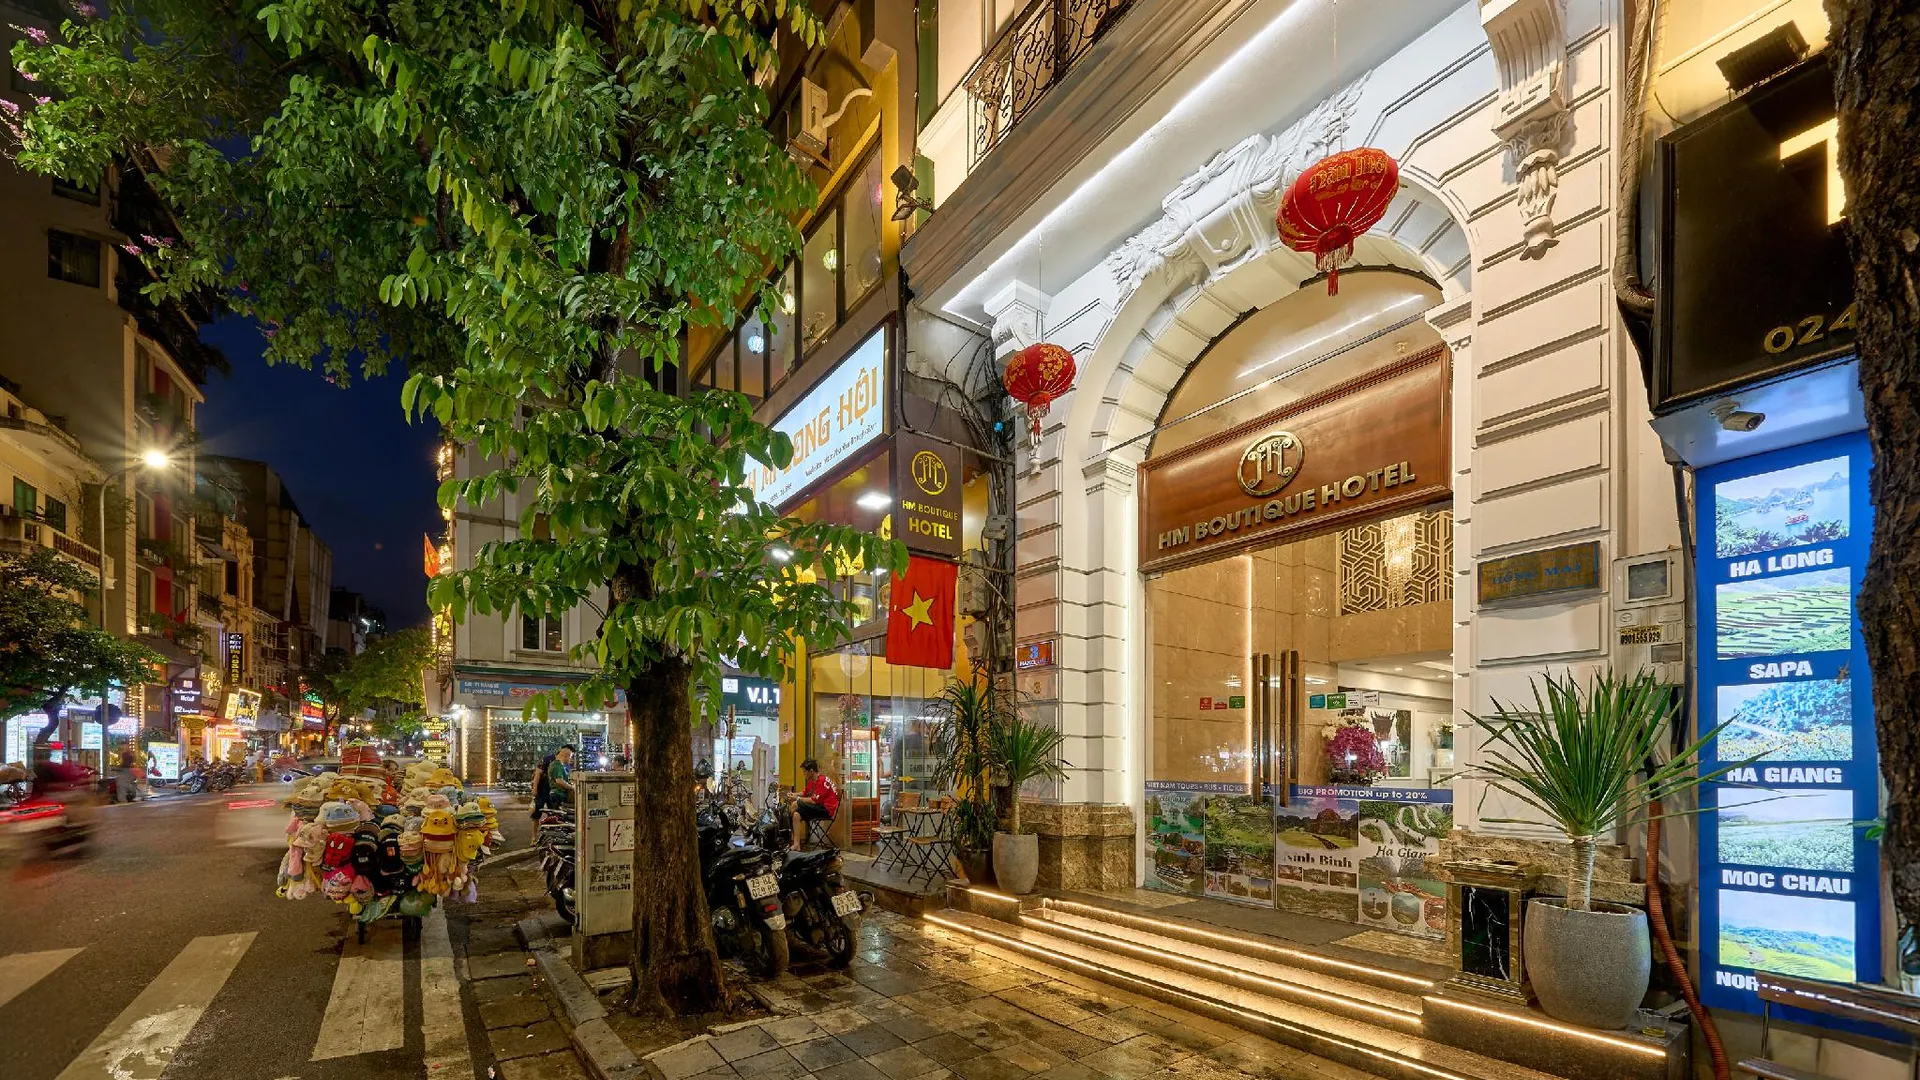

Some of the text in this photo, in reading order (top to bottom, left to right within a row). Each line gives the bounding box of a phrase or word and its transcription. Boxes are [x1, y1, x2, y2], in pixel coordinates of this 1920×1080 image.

[902, 500, 958, 519] HM BOUTIQUE
[1158, 461, 1416, 550] HM BOUTIQUE HOTEL
[908, 516, 953, 540] HOTEL
[1730, 548, 1834, 578] HA LONG
[1749, 661, 1813, 680] SAPA
[1727, 767, 1843, 784] HA GIANG
[1298, 788, 1428, 800] BIG PROMOTION up to 20%
[1375, 845, 1393, 857] Ha
[1319, 854, 1353, 869] Binh
[1721, 868, 1851, 894] MOC CHAU
